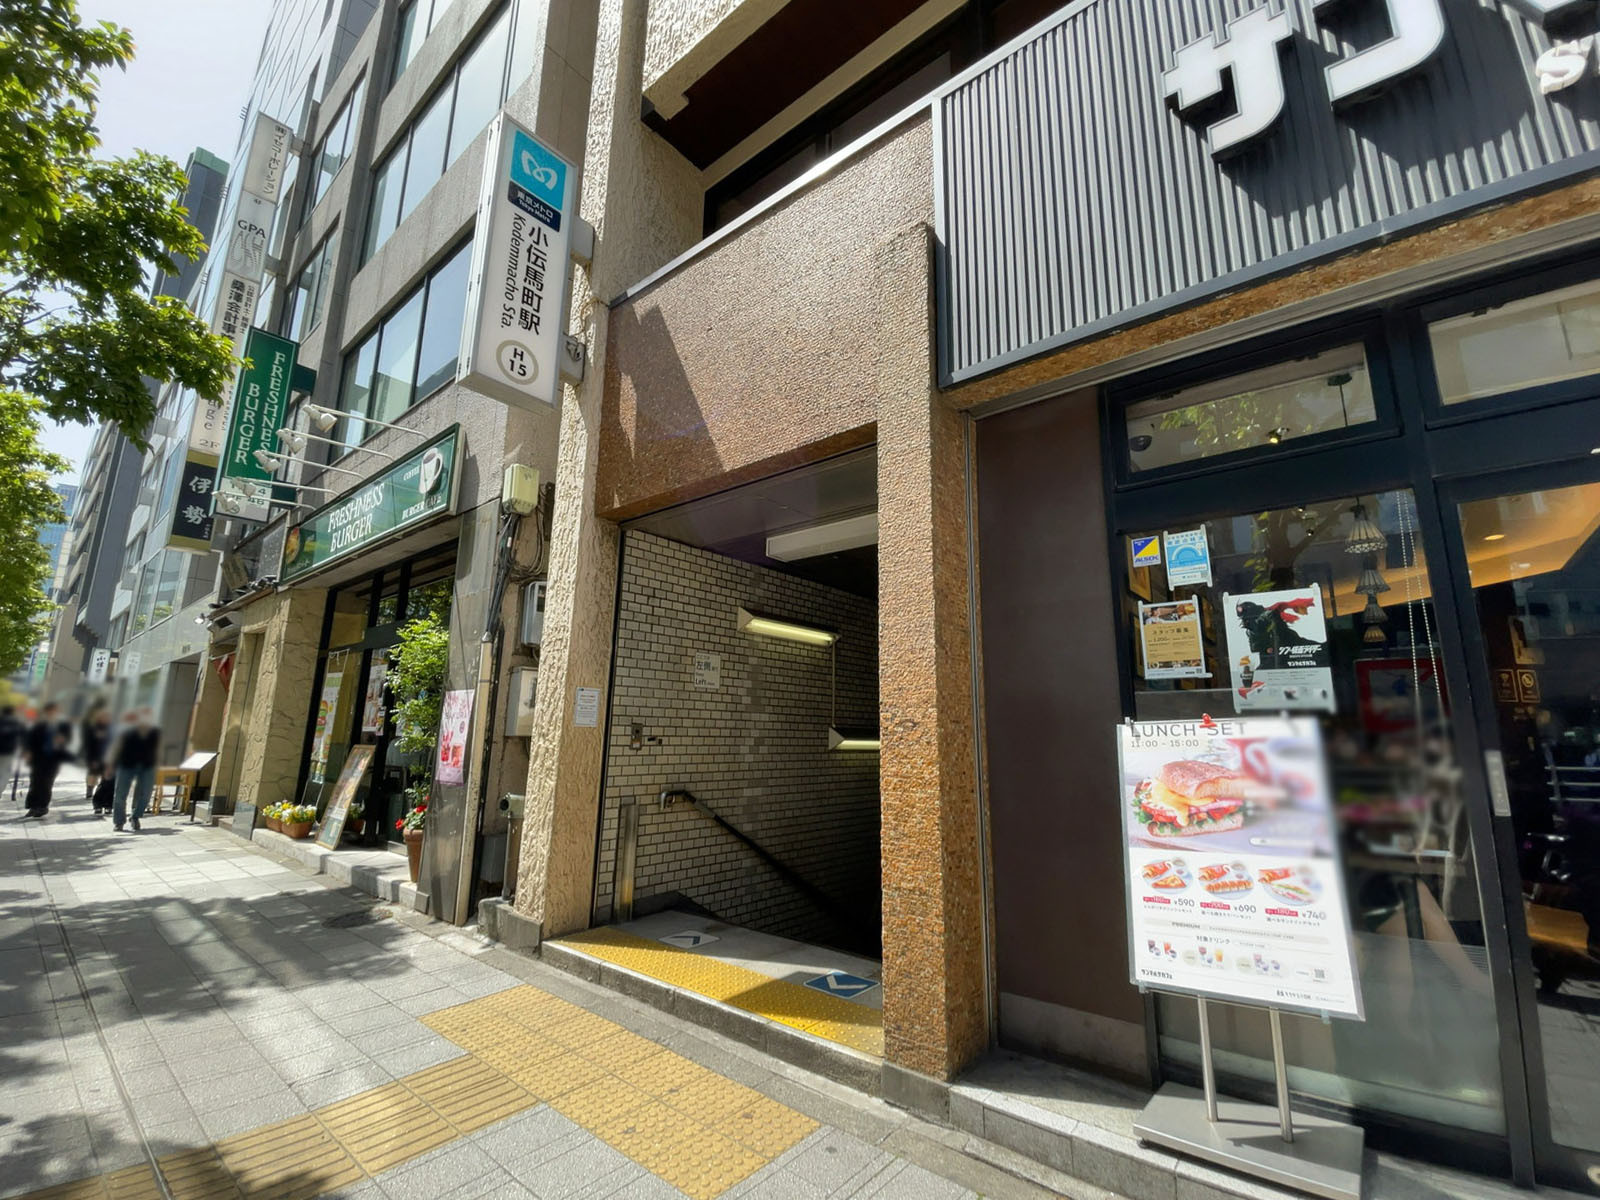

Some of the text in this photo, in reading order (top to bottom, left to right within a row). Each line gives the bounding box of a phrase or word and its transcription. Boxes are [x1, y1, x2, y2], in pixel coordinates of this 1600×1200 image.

[1161, 0, 1576, 154] サン
[1536, 32, 1600, 94] S
[516, 190, 553, 219] 東京メトロ
[238, 219, 266, 239] GPA
[501, 213, 526, 329] Kodemmacho Sta.
[518, 226, 549, 335] 小伝馬町駅
[509, 360, 527, 377] 15
[512, 347, 524, 362] H
[235, 382, 261, 465] BURGER
[255, 351, 285, 469] FRESHNES
[181, 475, 213, 525] 伊勢
[328, 482, 384, 533] FRESHNESS
[330, 513, 373, 552] BURGER
[1134, 555, 1159, 563] ALSOK
[1131, 740, 1158, 748] 11:00
[1170, 738, 1199, 747] 15:00
[1132, 722, 1247, 737] LUNCH SET
